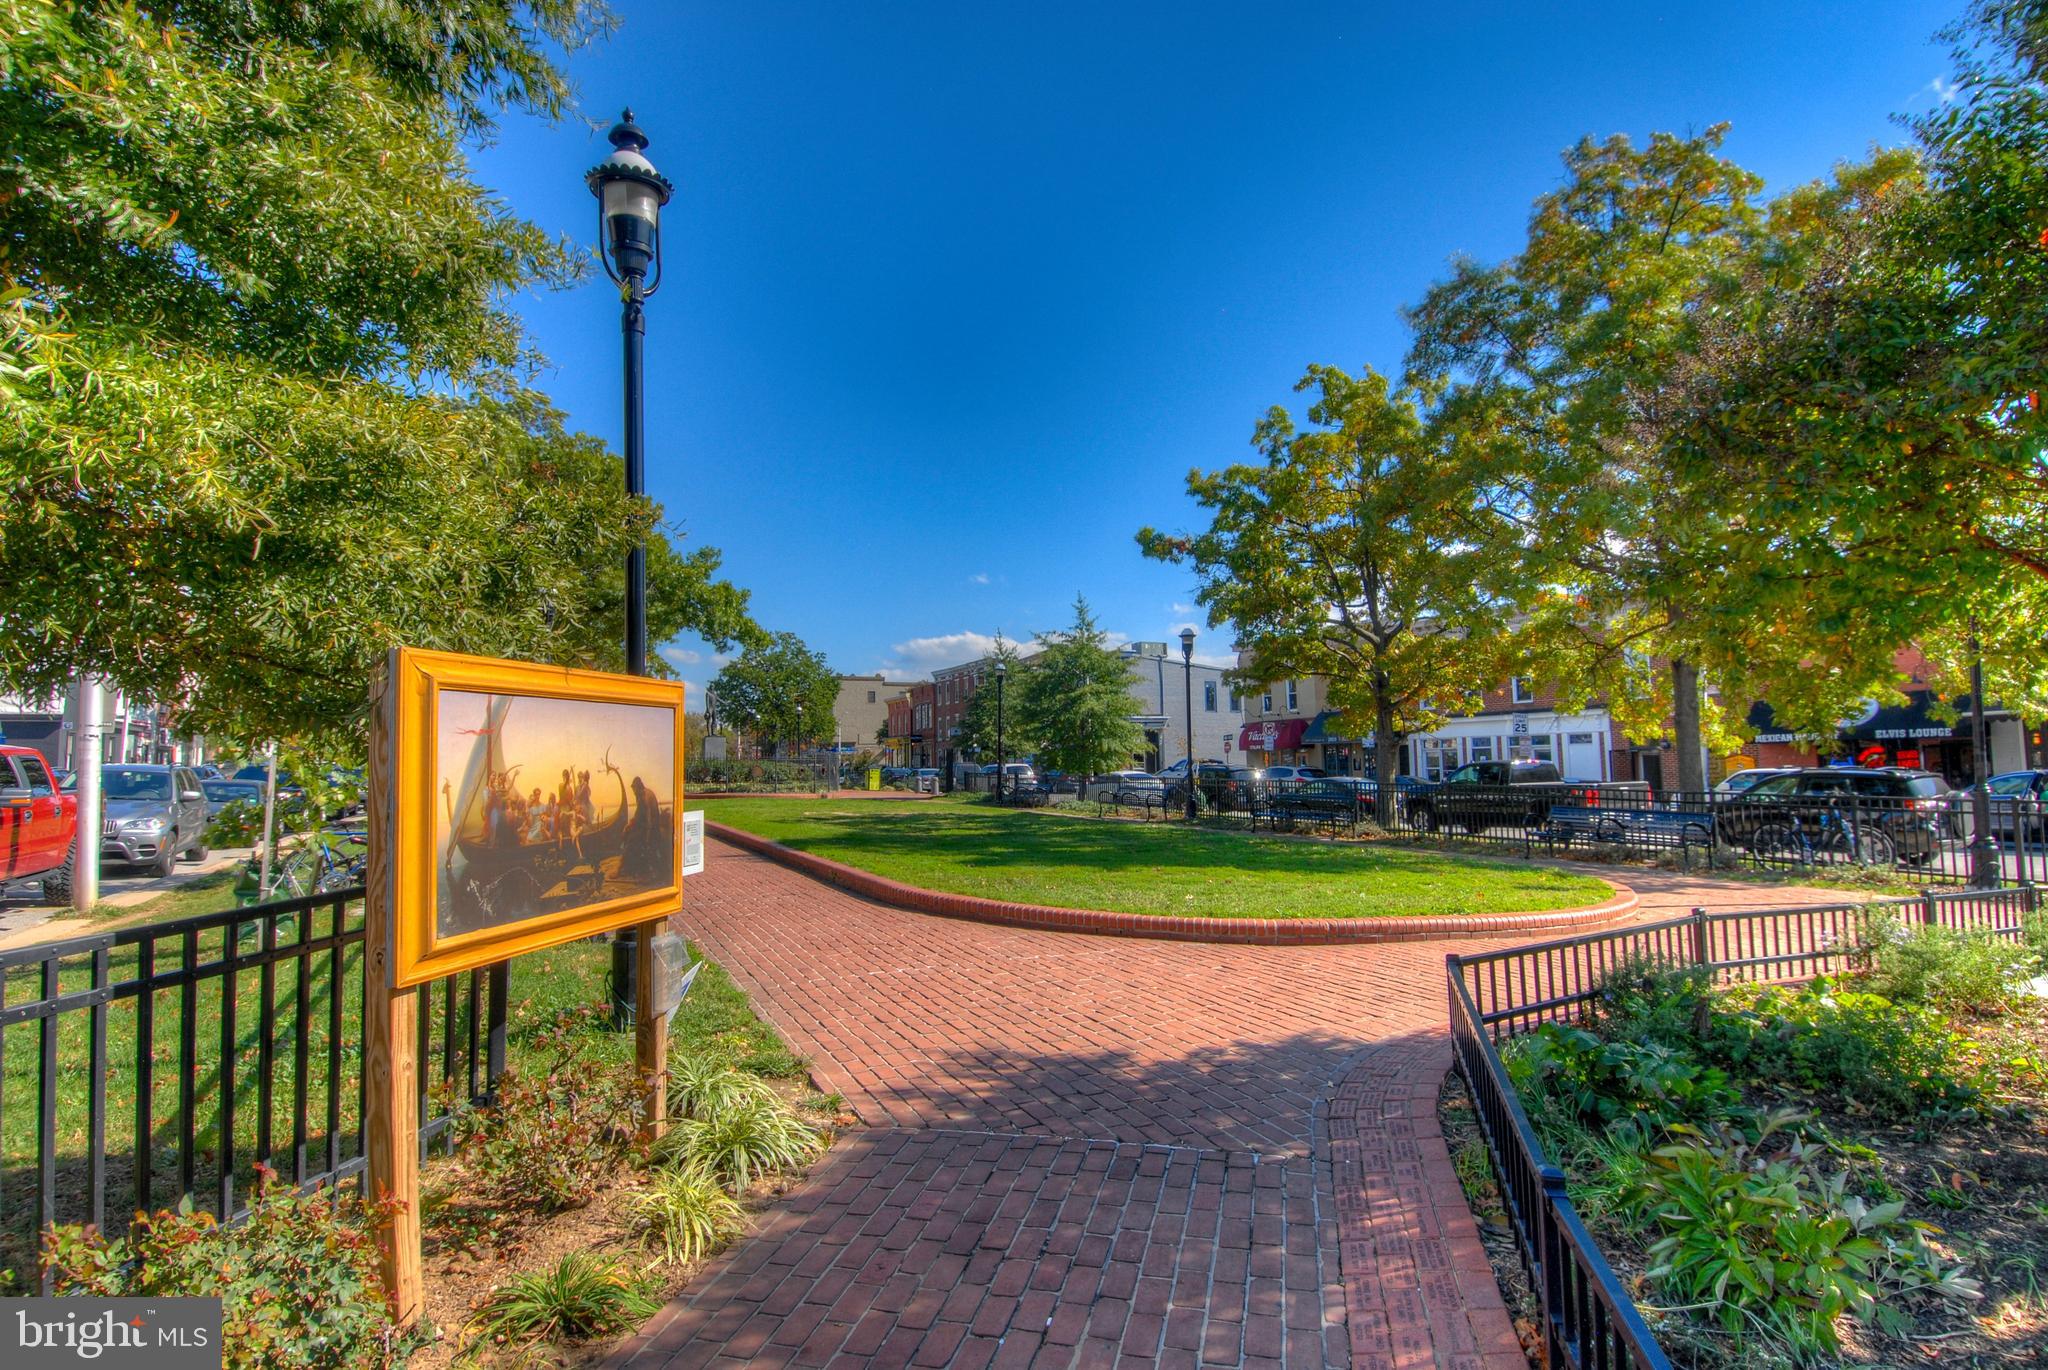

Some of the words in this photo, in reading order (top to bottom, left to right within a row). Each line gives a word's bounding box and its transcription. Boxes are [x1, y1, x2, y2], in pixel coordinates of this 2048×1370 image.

[1515, 724, 1527, 732] 25
[1755, 733, 1793, 743] MEXICAN
[1875, 729, 1906, 739] ELVIS
[1908, 728, 1953, 738] LOUNGE
